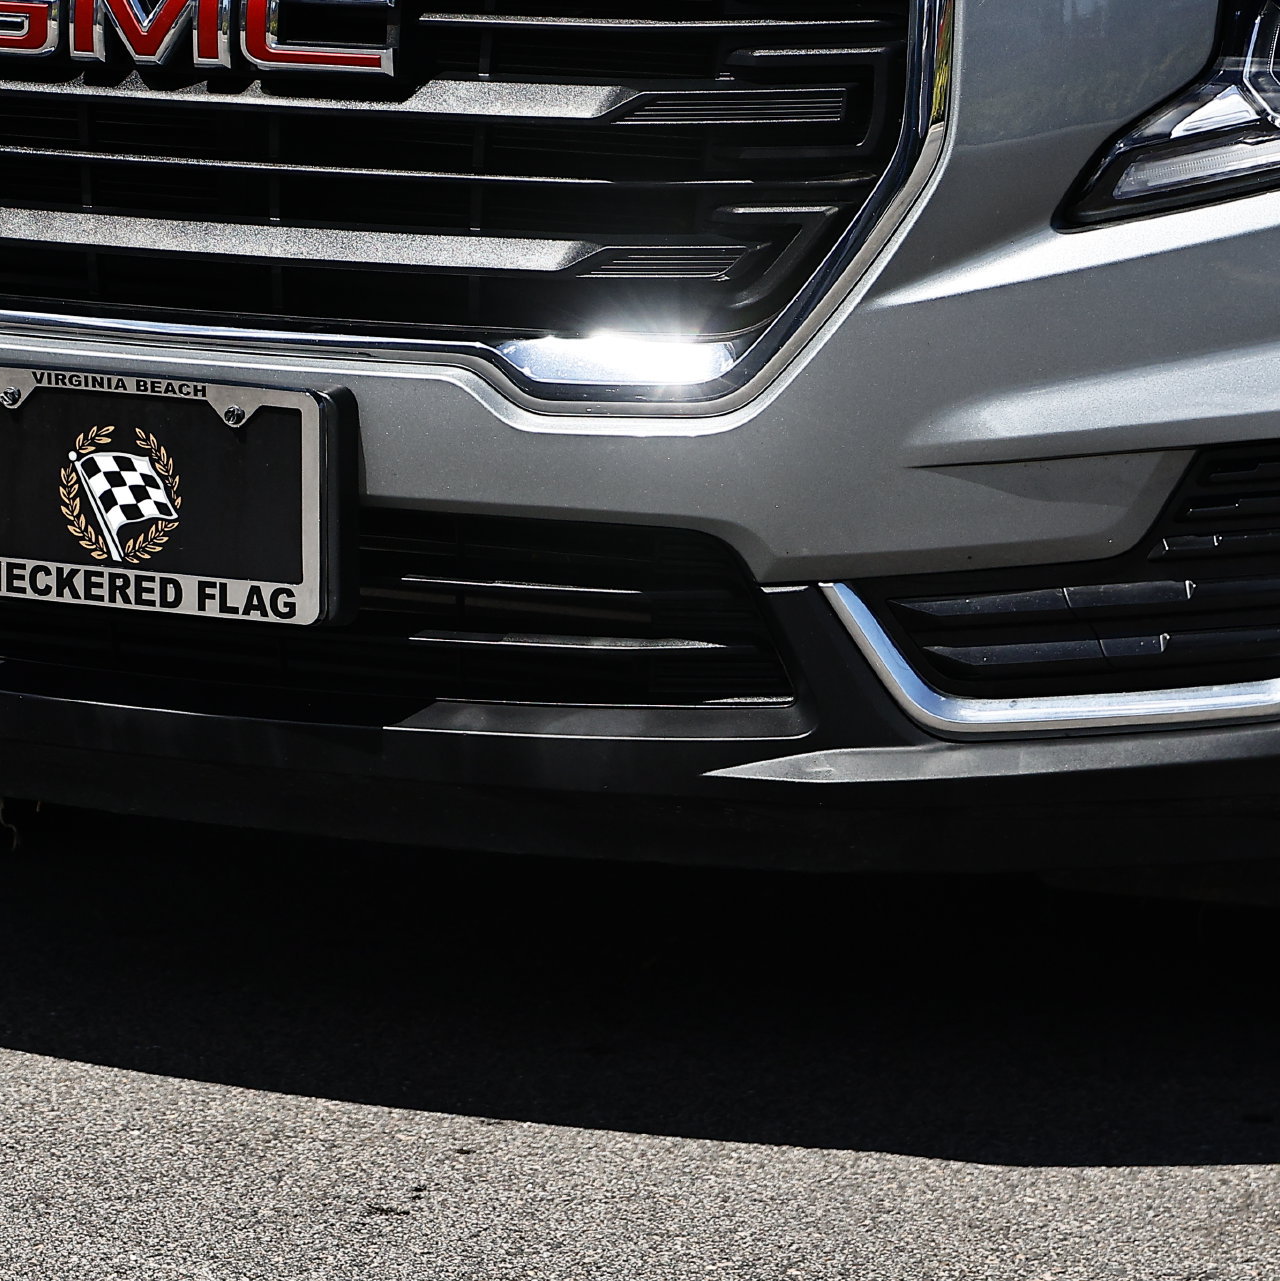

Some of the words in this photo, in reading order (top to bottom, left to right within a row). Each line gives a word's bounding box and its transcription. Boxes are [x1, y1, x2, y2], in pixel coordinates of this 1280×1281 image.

[31, 370, 128, 392] VIRGINIA
[135, 378, 208, 399] BEACH
[197, 580, 298, 620] FLAG
